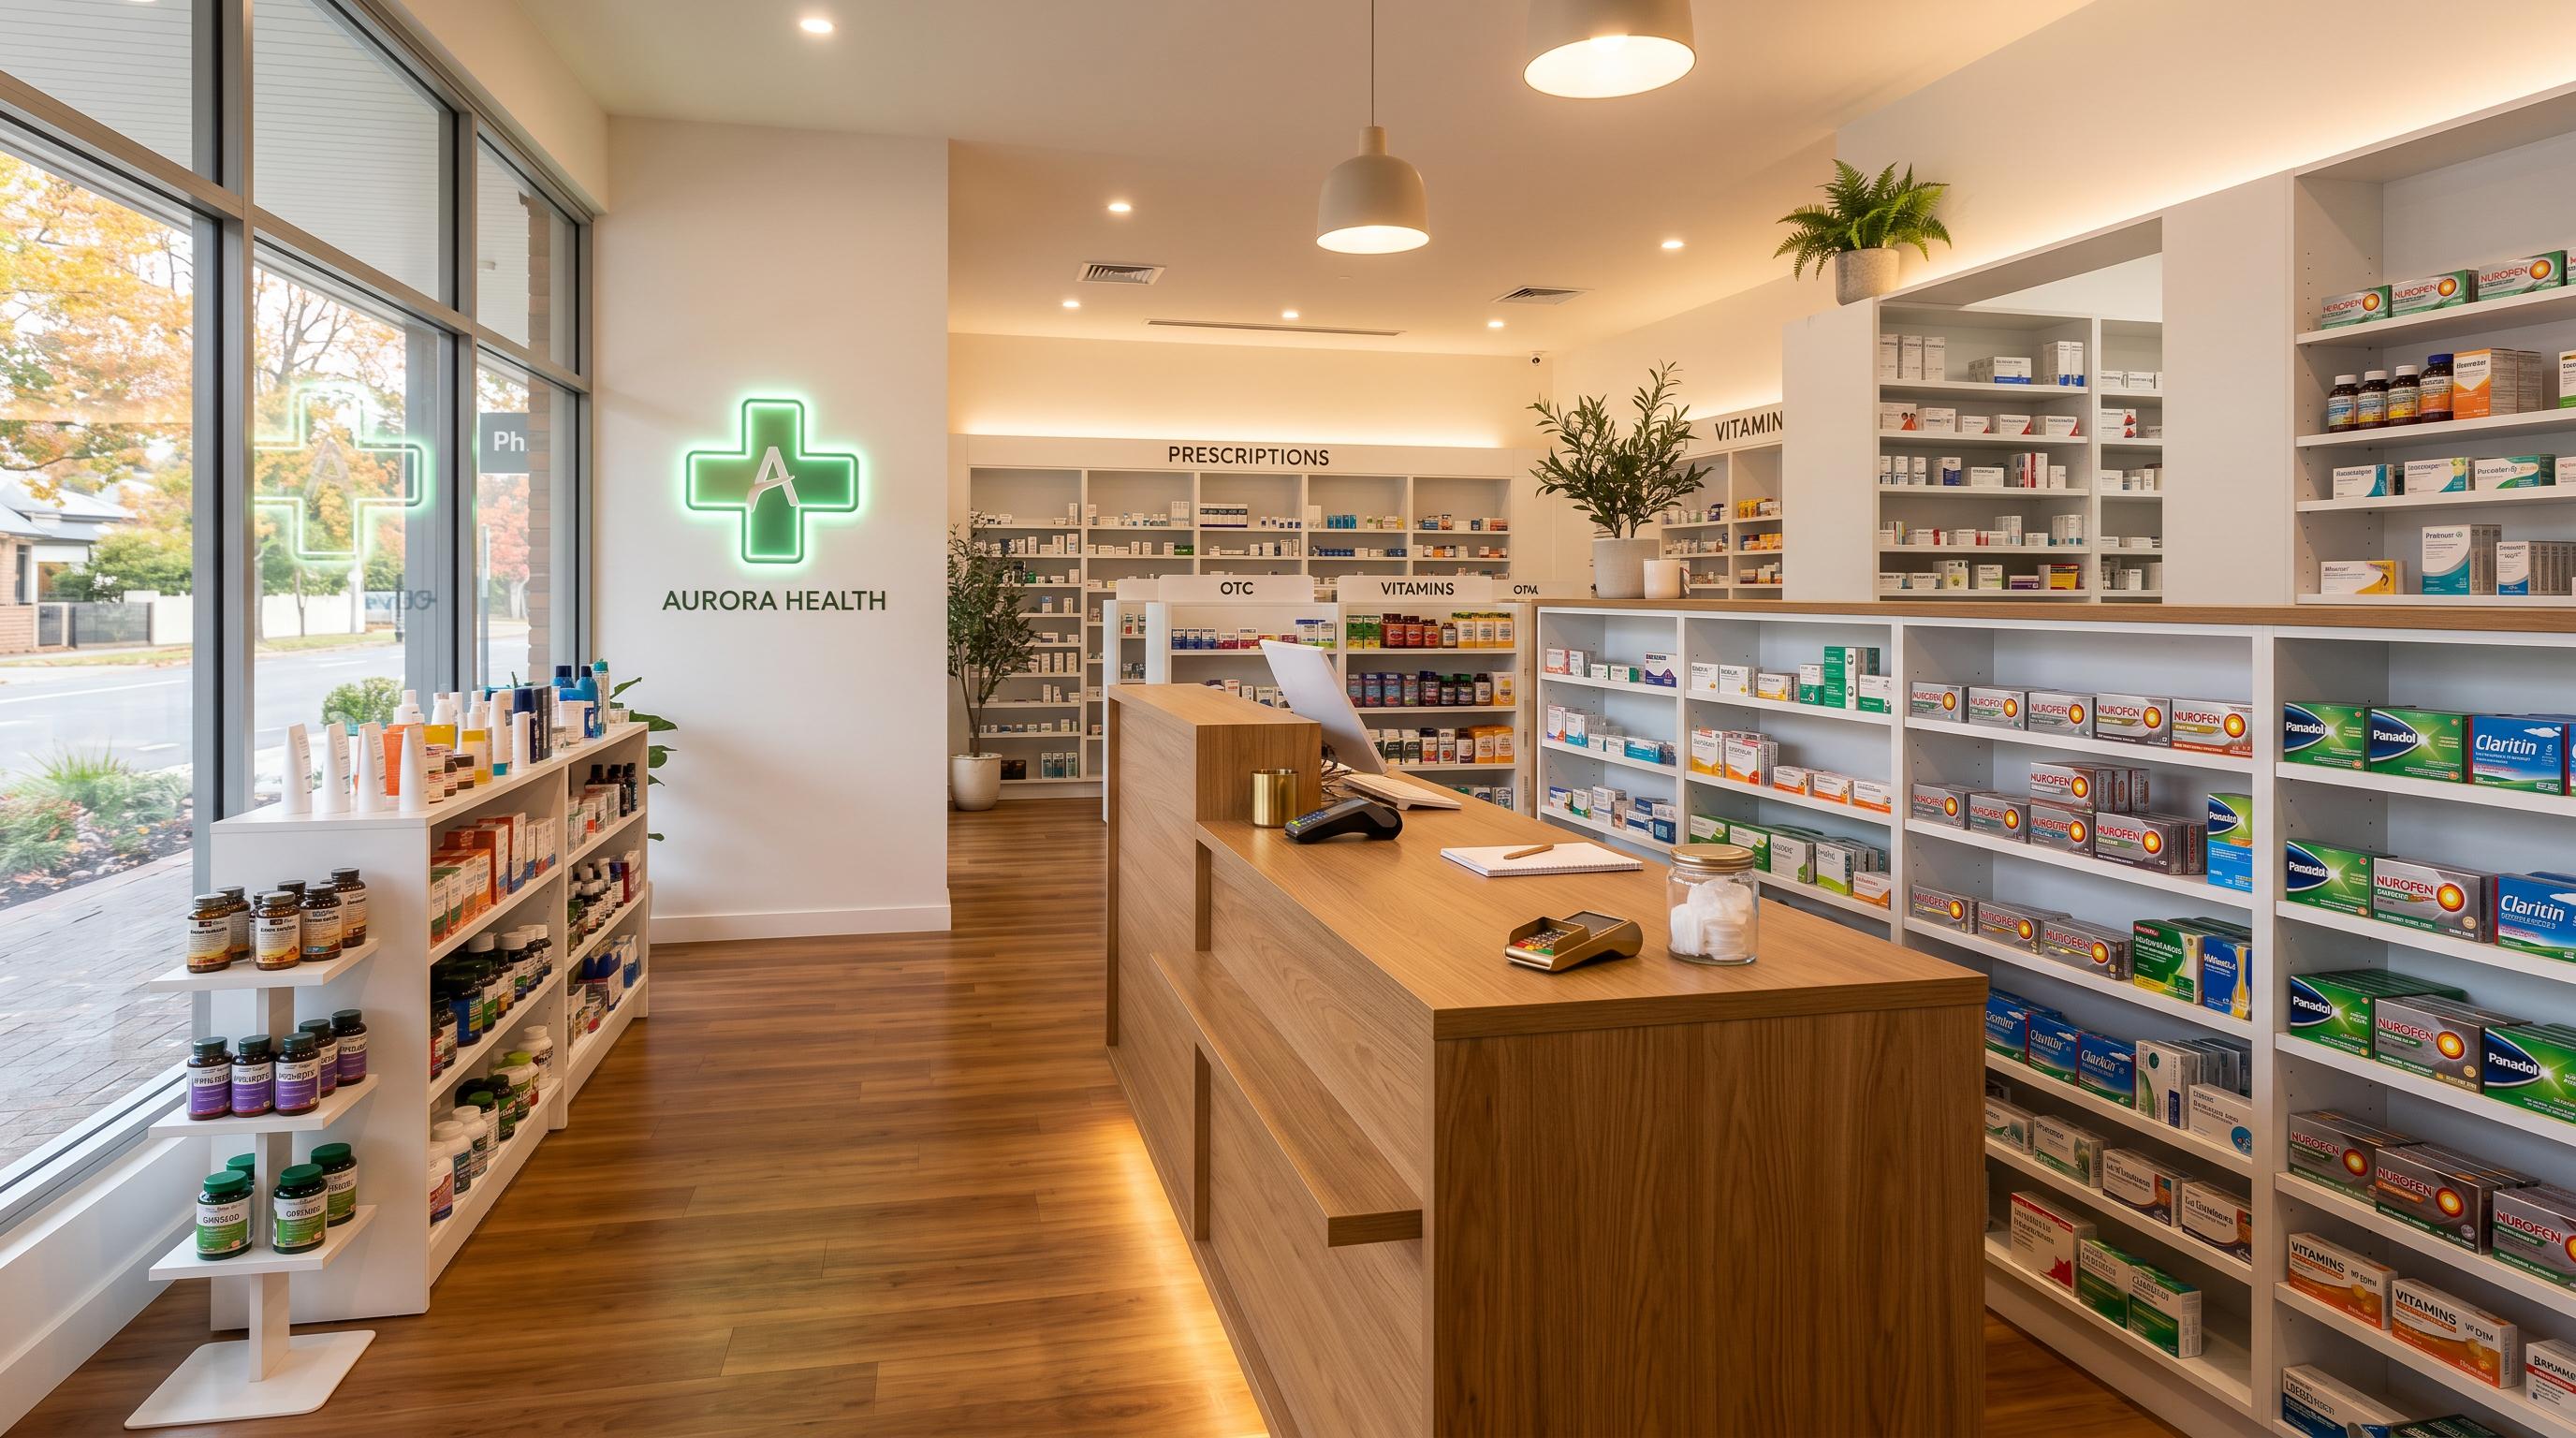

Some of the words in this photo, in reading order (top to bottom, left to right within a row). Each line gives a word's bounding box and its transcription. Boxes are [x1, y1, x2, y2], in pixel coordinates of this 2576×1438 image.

[1715, 410, 1782, 441] VITAMIN
[493, 431, 530, 452] Ph
[1168, 446, 1330, 466] PRESCRIPTIONS
[746, 446, 800, 512] A
[1220, 581, 1254, 595] OTC
[1381, 581, 1455, 596] VITAMINS
[662, 590, 778, 610] AURORA
[786, 590, 886, 610] HEALTH
[2286, 720, 2324, 736] Panadol
[2373, 728, 2416, 745] Panadol
[2475, 734, 2538, 756] Claritin
[2030, 772, 2071, 787] NUROFEN
[2097, 824, 2140, 842] NUROFEN
[2377, 875, 2435, 896] NUROFEN
[2500, 894, 2565, 922] Claritin
[2292, 996, 2331, 1015] Panadol
[2378, 1019, 2434, 1042] NUROFEN
[2488, 1052, 2538, 1076] Panadol
[2378, 1167, 2432, 1197] NUROFEN
[2291, 1240, 2346, 1274] VITAMINS
[2395, 1288, 2457, 1326] VITAMINS
